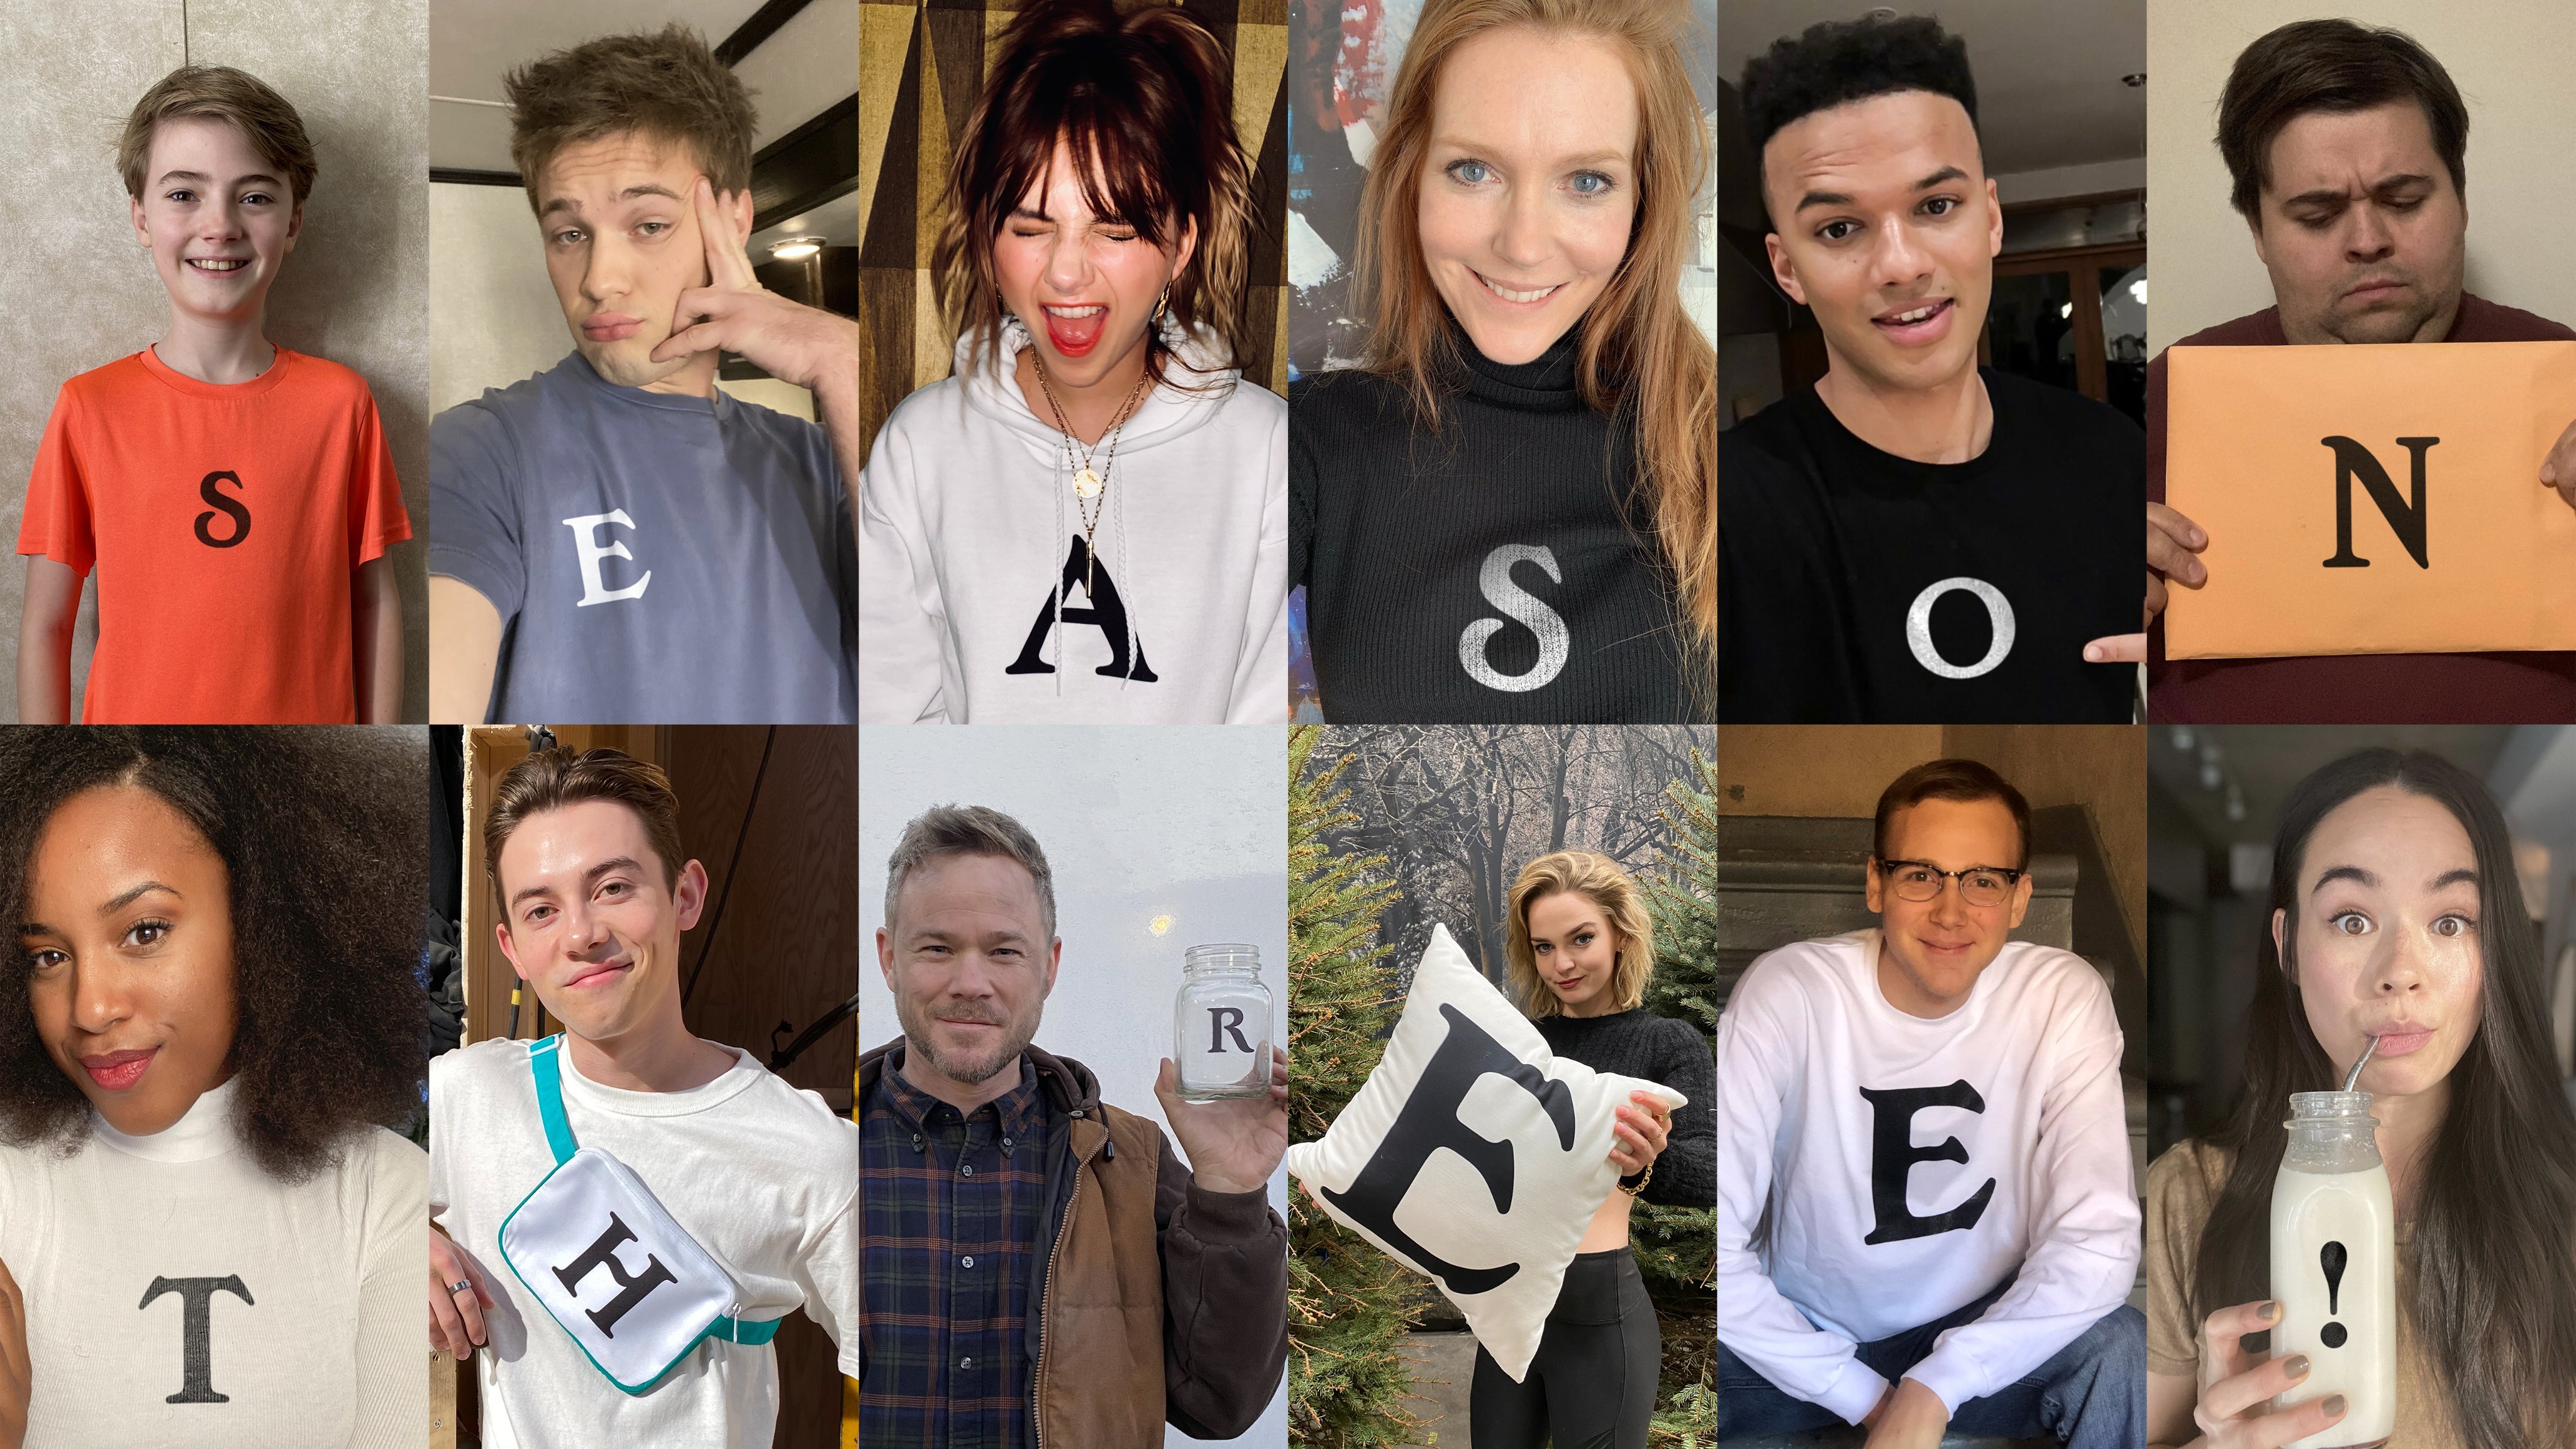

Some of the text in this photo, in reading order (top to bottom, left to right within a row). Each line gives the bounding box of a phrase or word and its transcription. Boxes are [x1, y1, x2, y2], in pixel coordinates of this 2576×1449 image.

[194, 470, 251, 548] S
[562, 509, 651, 607] E
[2321, 436, 2440, 569] N
[1006, 535, 1158, 682] A
[1459, 544, 1569, 692] S
[1906, 577, 2015, 679] O
[1207, 1008, 1254, 1053] R
[1321, 1002, 1575, 1294] E
[1860, 1079, 1996, 1245] E
[139, 1274, 254, 1404] T
[552, 1211, 678, 1339] H
[2321, 1241, 2347, 1348] !
